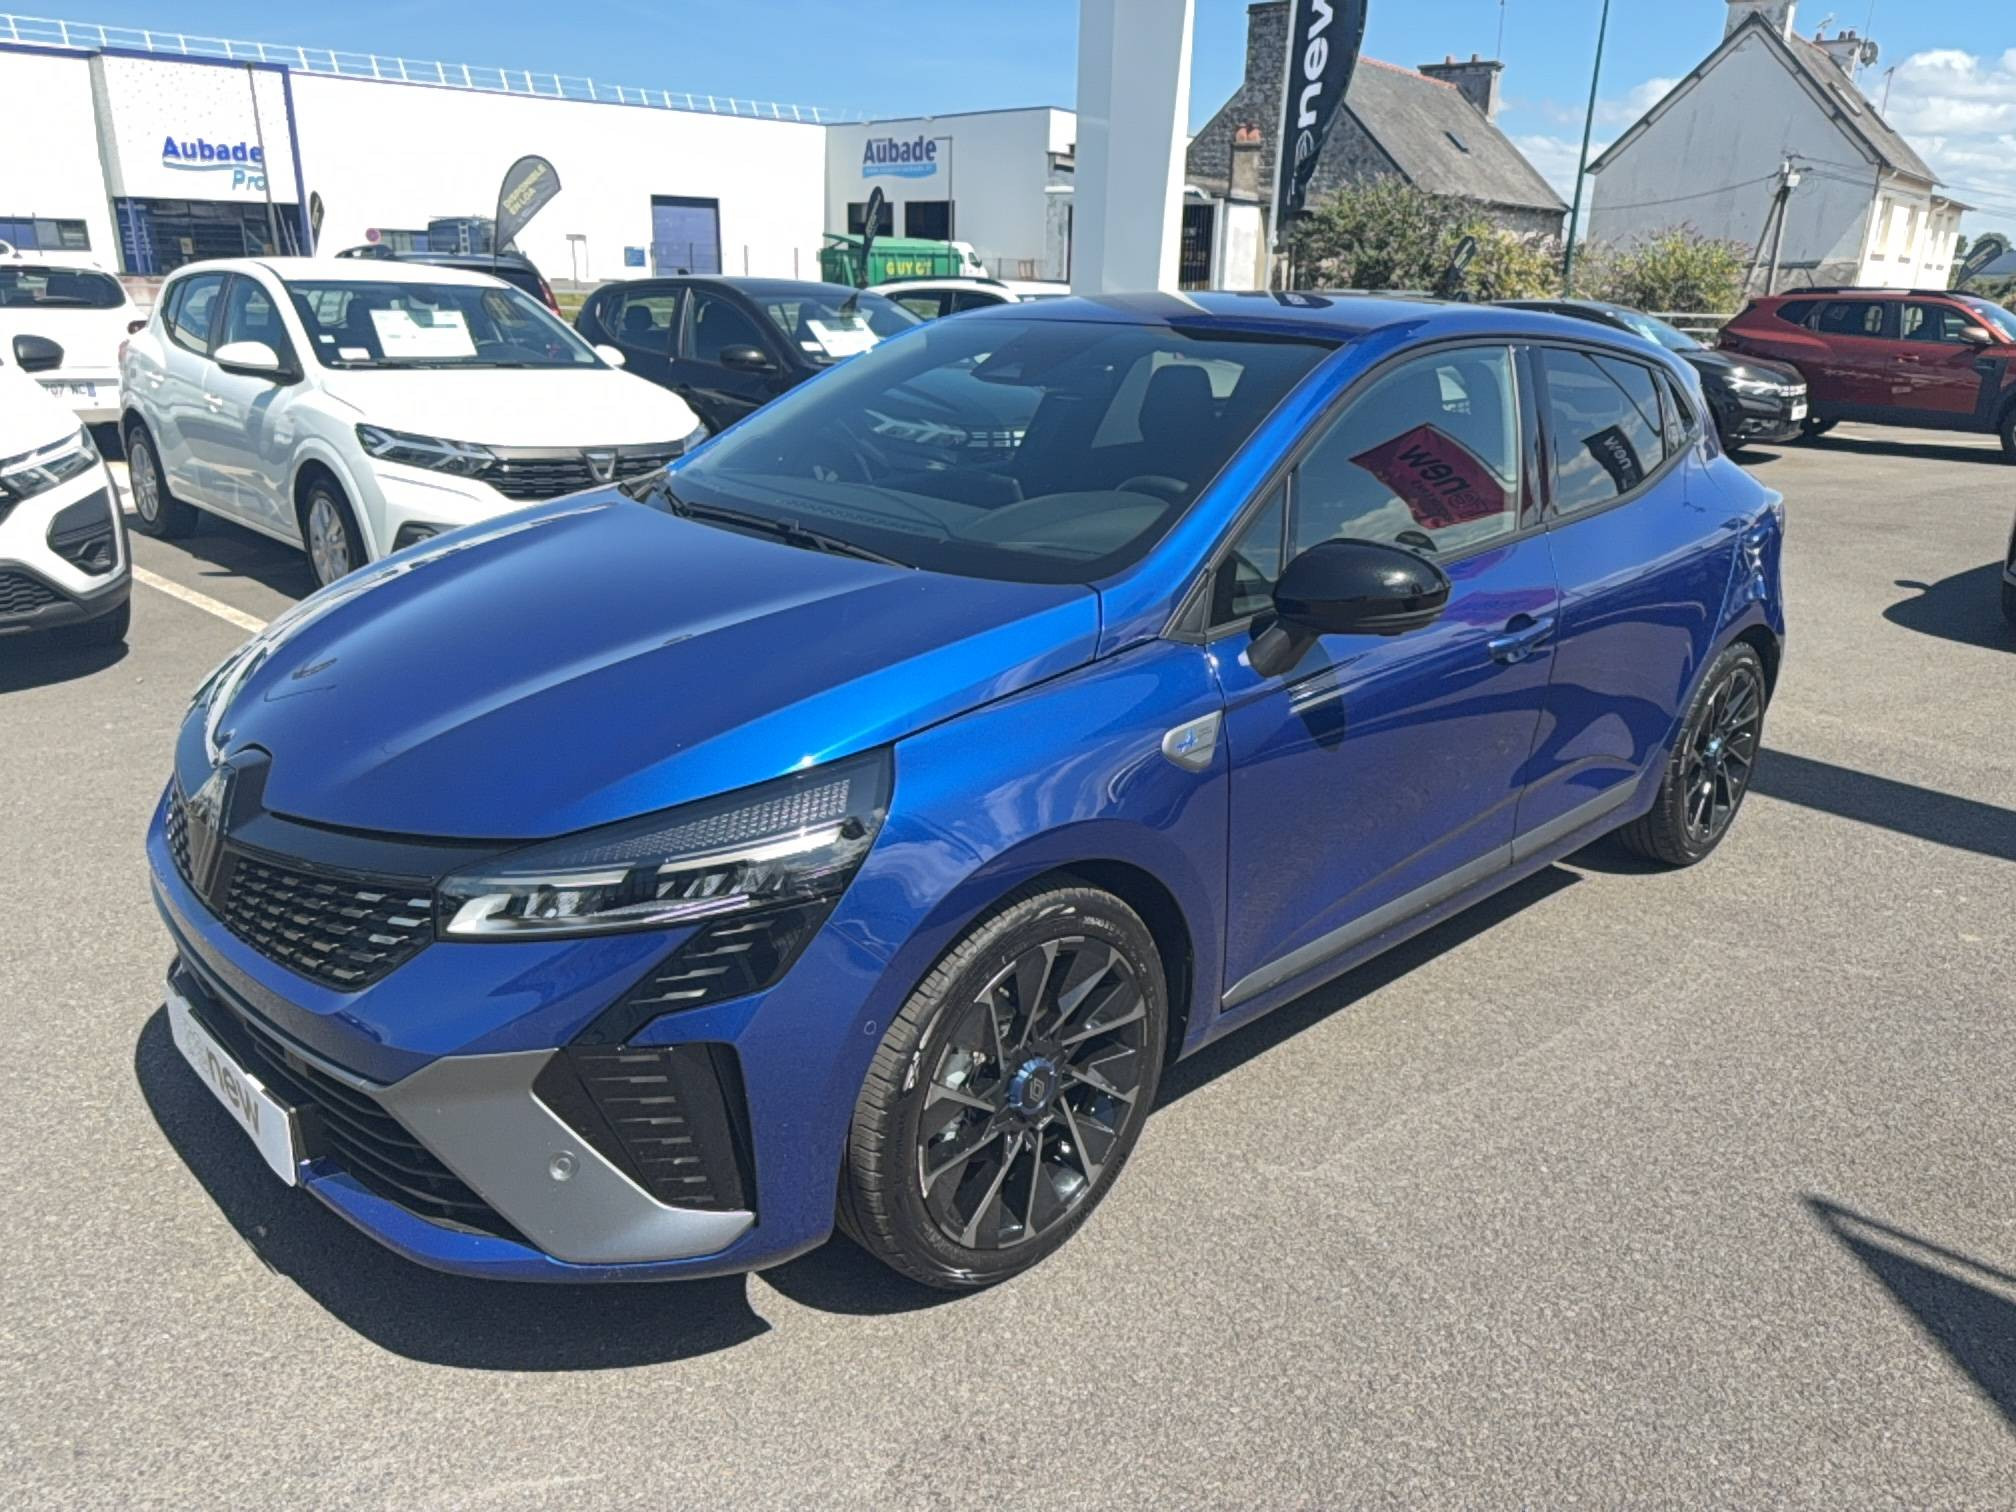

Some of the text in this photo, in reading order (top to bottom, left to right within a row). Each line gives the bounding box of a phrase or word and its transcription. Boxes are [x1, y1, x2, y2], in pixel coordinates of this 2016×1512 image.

[162, 135, 264, 163] Aubade
[863, 134, 937, 165] Aubade
[231, 168, 266, 191] Pro
